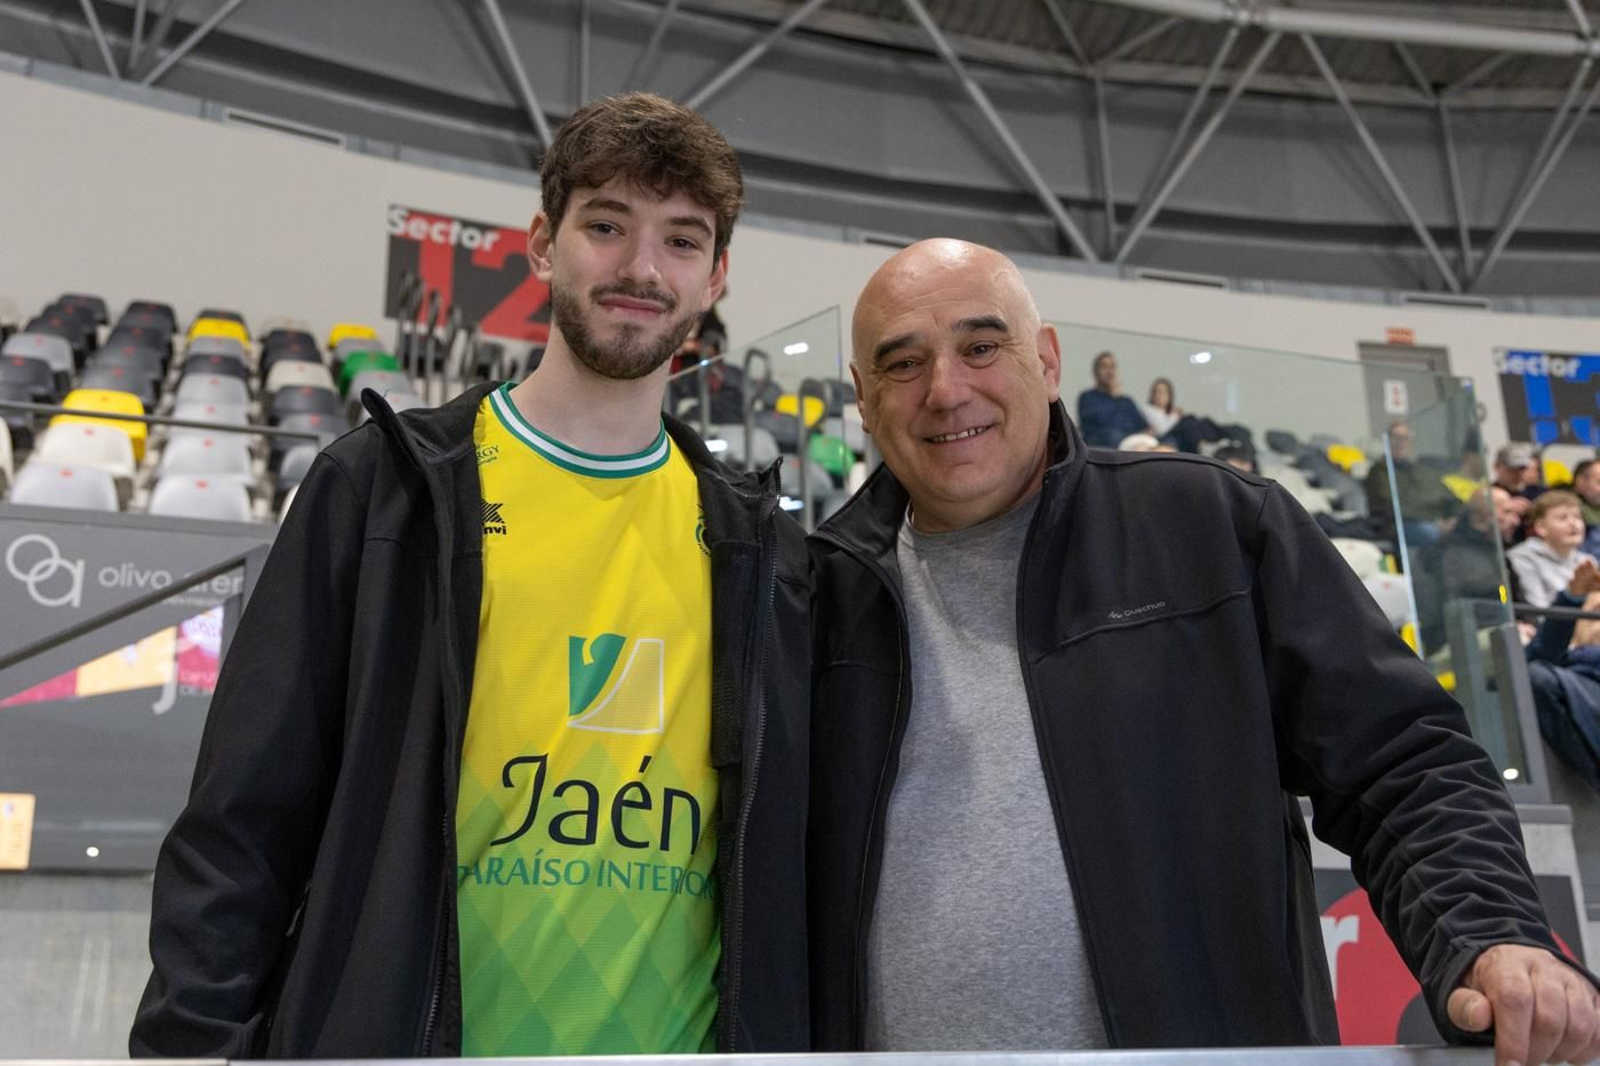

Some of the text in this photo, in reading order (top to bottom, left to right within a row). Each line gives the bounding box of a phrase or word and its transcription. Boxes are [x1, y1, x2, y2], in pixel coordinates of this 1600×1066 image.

[385, 204, 500, 252] Sector
[1490, 346, 1582, 379] Sector
[98, 562, 173, 590] olivo
[489, 752, 702, 856] Jaén
